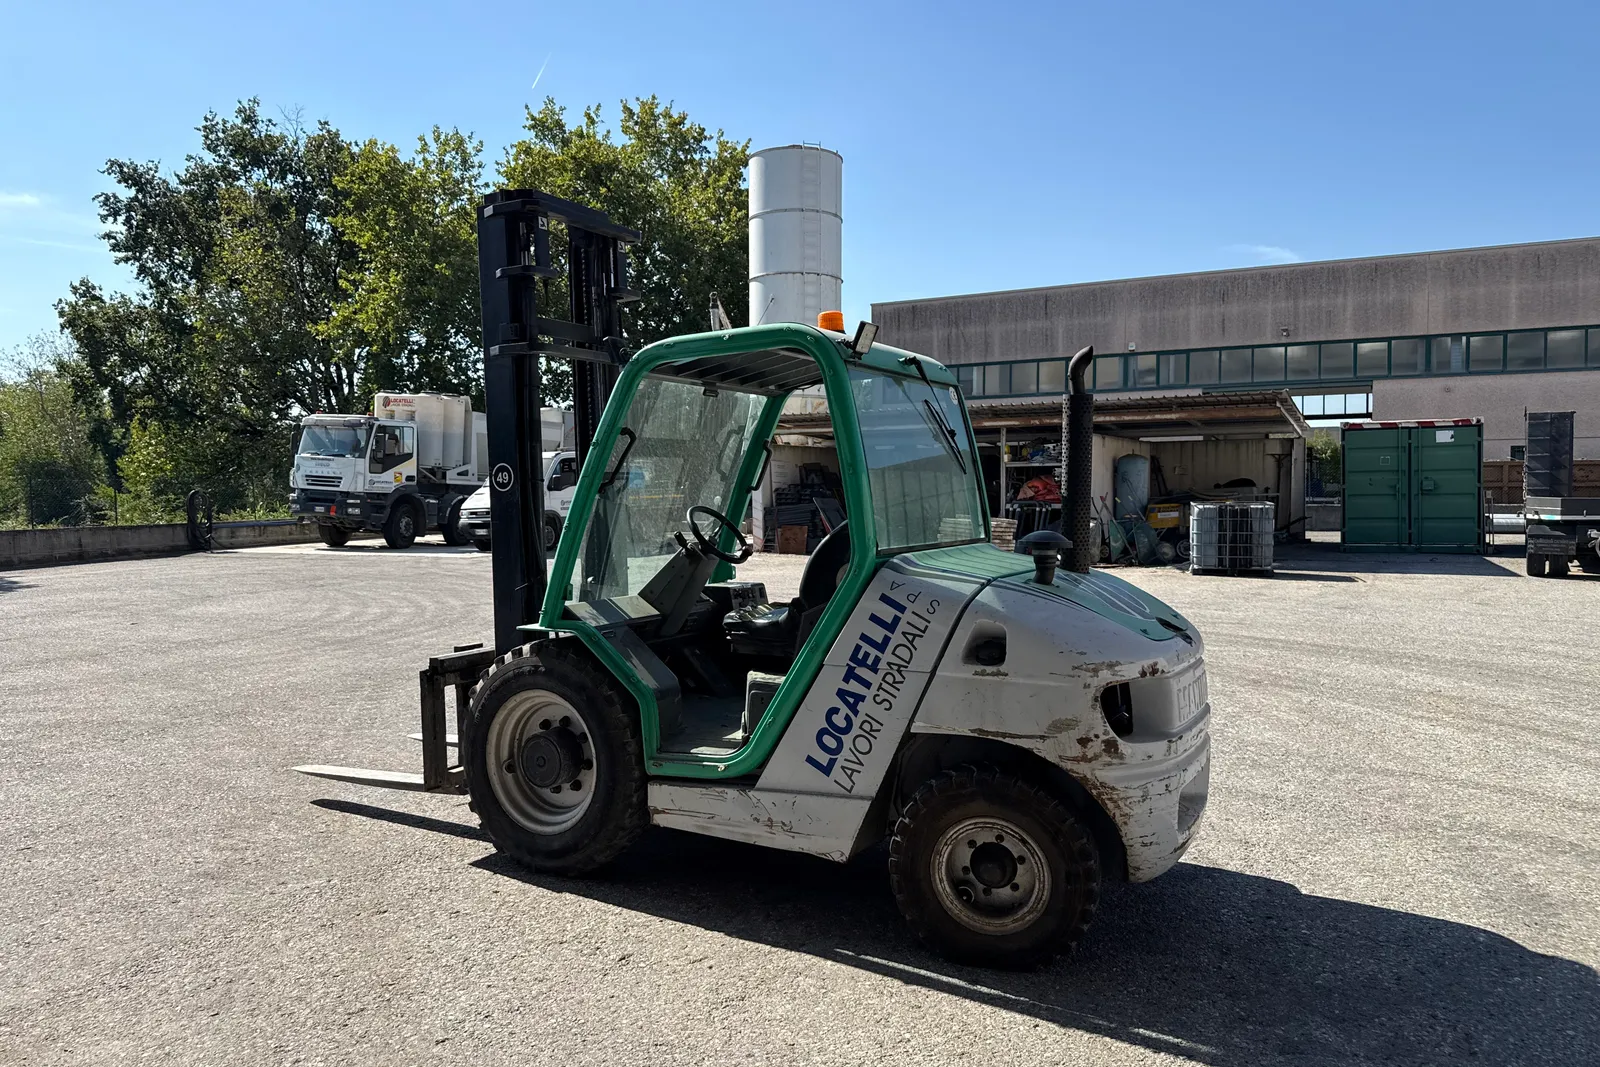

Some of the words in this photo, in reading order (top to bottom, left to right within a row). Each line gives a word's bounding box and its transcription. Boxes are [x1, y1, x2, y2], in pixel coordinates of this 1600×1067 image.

[496, 471, 509, 484] 49
[804, 592, 908, 778] LOCATELLI
[833, 712, 884, 795] LAVORI
[872, 610, 932, 712] STRADALI
